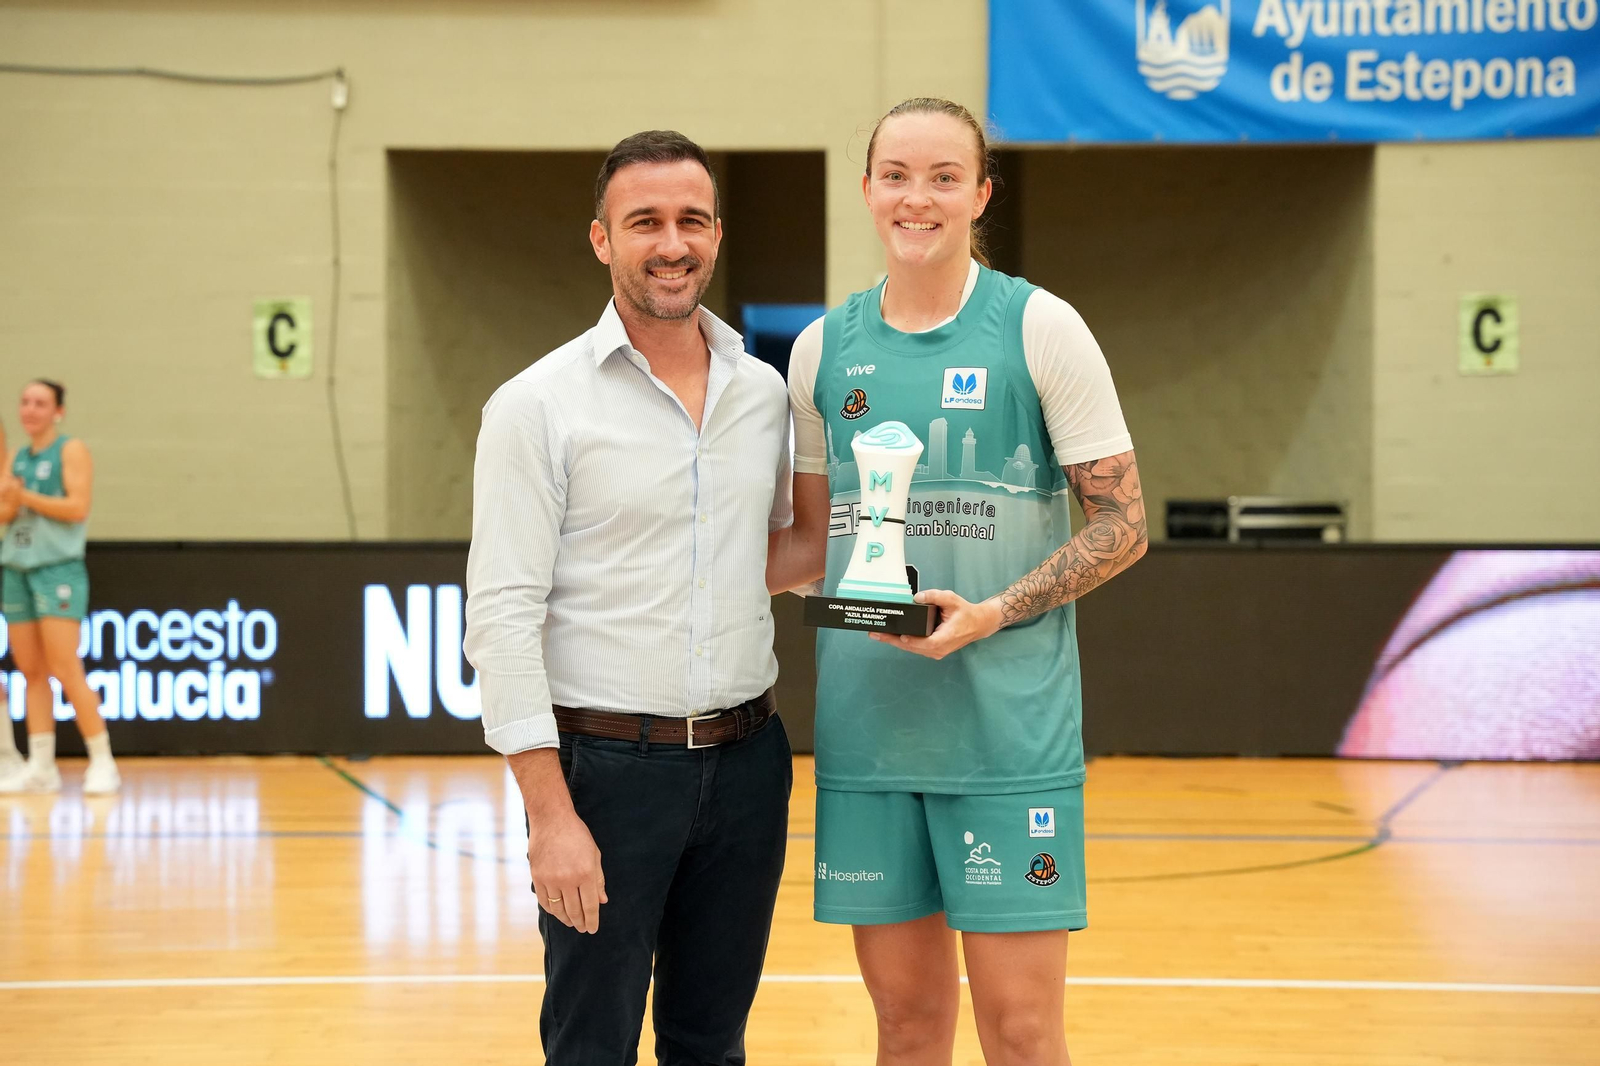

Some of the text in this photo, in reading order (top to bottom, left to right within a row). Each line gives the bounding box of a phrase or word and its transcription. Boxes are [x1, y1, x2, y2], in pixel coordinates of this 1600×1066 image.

[1252, 0, 1598, 48] Ayuntamiento
[1269, 49, 1576, 110] de Estepona
[268, 312, 296, 358] C
[1472, 307, 1503, 354] C
[846, 363, 876, 377] vive
[906, 498, 996, 518] ingeniería
[905, 520, 995, 540] ambiental
[829, 869, 884, 884] Hospiten
